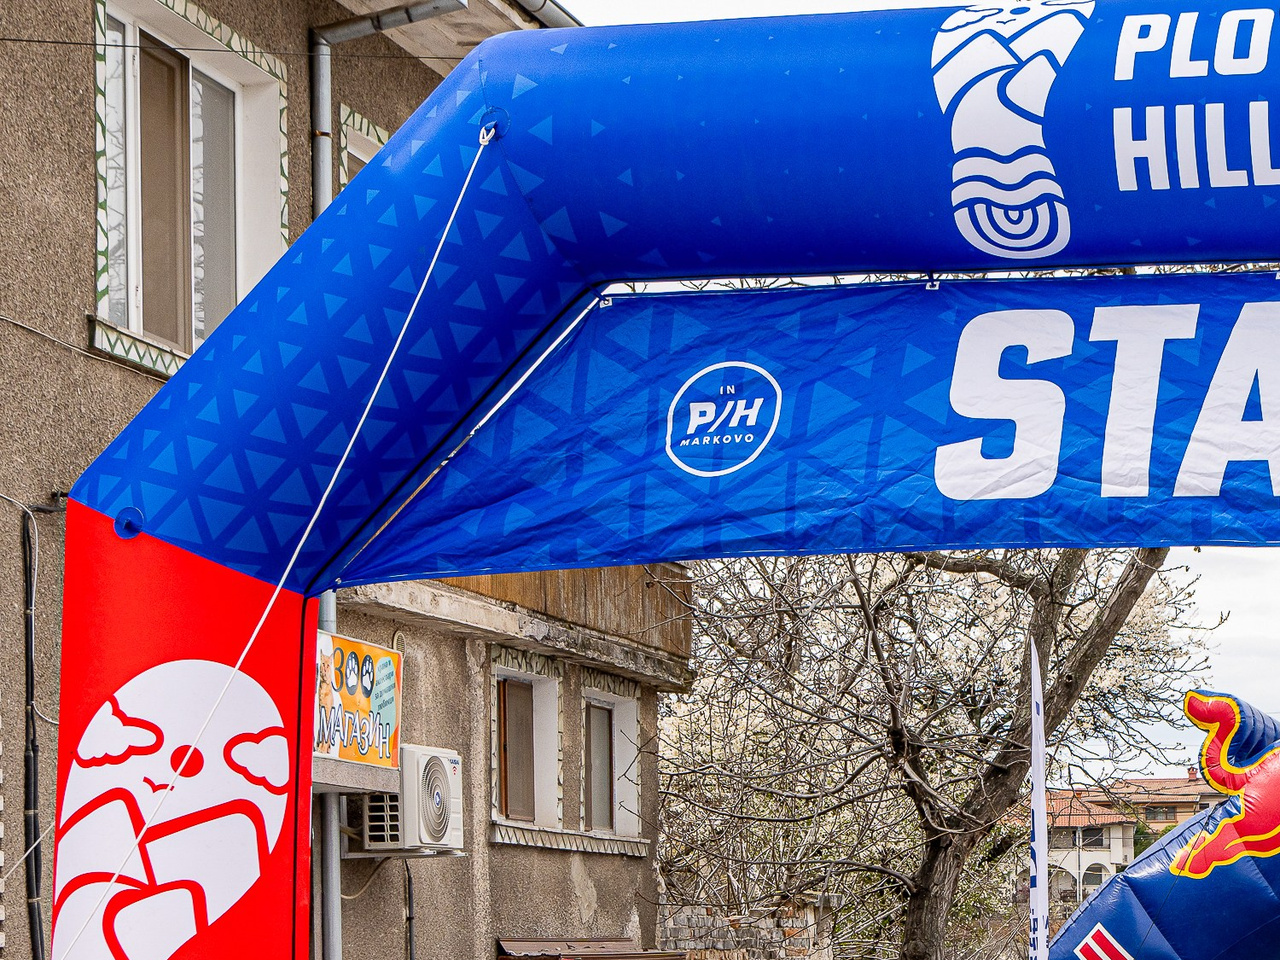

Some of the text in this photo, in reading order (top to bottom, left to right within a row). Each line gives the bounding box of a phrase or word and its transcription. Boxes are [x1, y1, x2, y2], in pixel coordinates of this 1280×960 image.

[719, 385, 736, 395] IN
[686, 397, 765, 435] P/H
[679, 433, 754, 447] MARKOVO
[318, 703, 391, 759] МАГАЗИН
